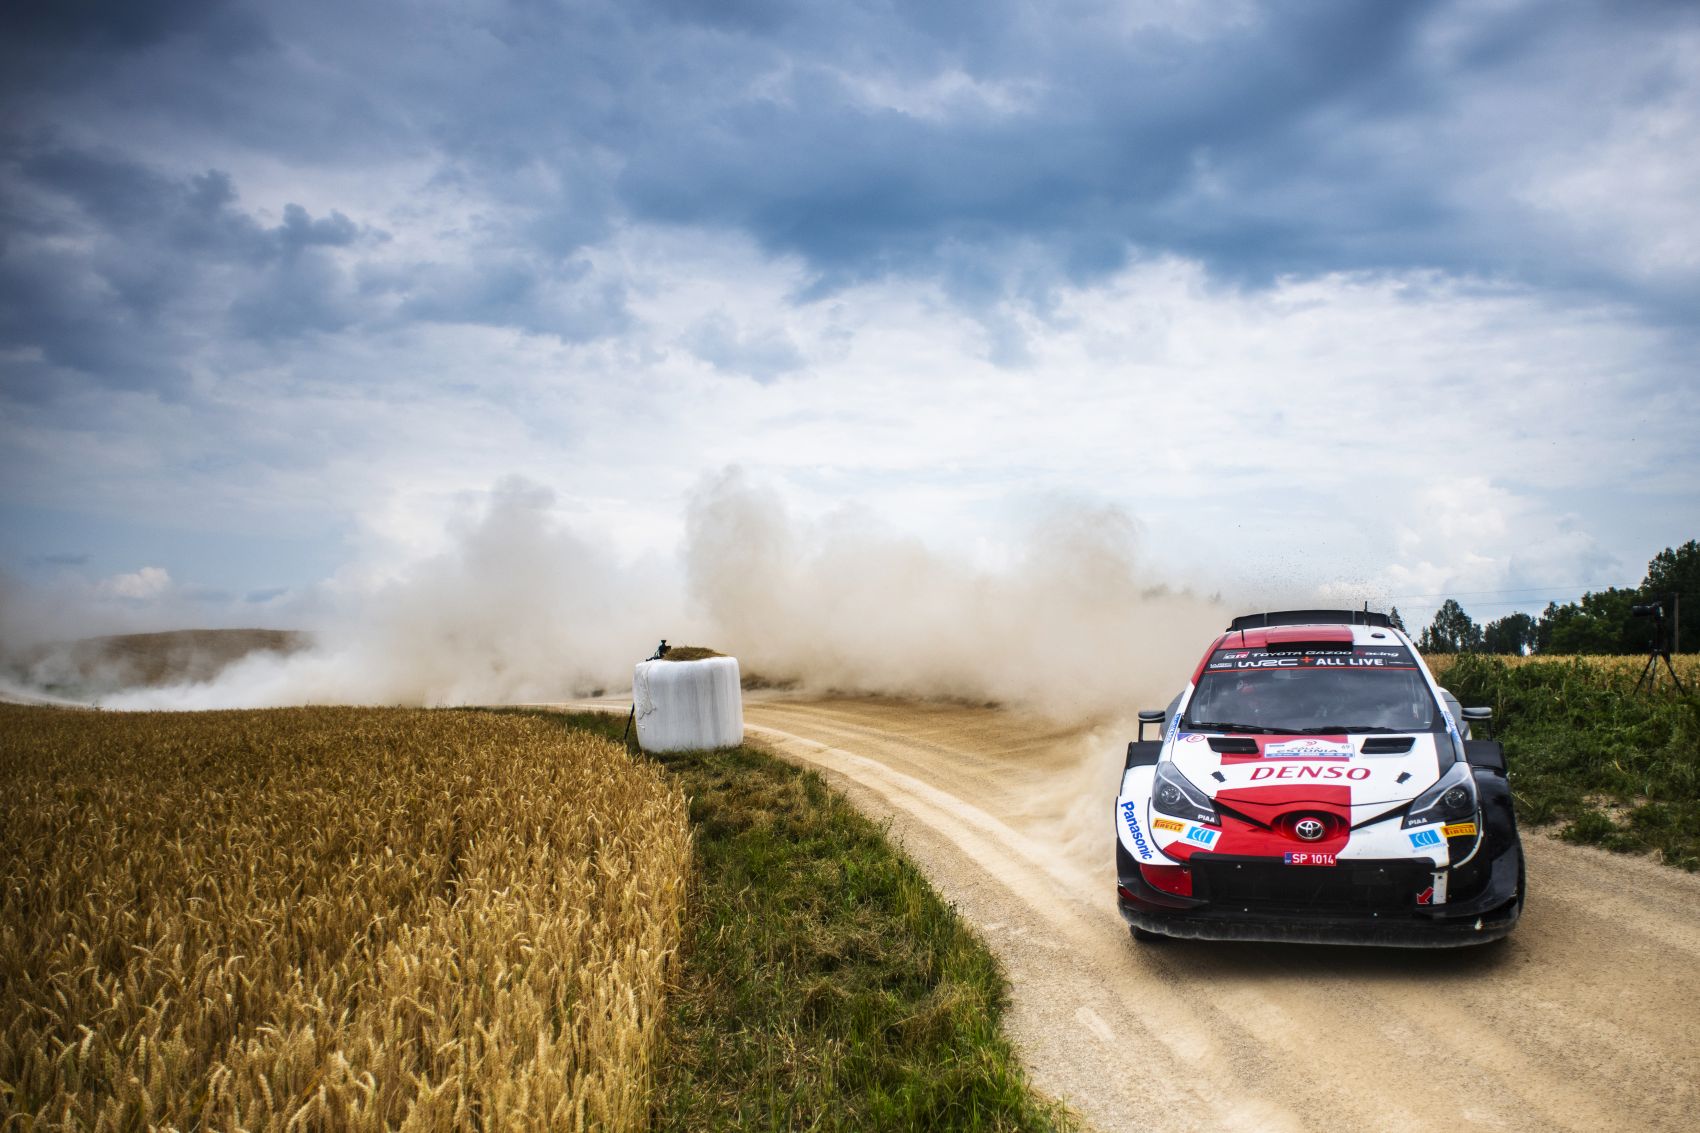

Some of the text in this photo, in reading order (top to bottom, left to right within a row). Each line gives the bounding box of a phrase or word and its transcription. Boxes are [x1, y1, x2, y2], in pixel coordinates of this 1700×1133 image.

[1238, 658, 1298, 668] WRC
[1316, 658, 1345, 666] ALL
[1350, 658, 1384, 666] LIVE
[1250, 766, 1371, 780] DENSO
[1198, 814, 1215, 823] PIAA
[1408, 818, 1427, 826] PIAA
[1121, 801, 1153, 860] Panasonic
[1292, 853, 1334, 865] SP 1014
